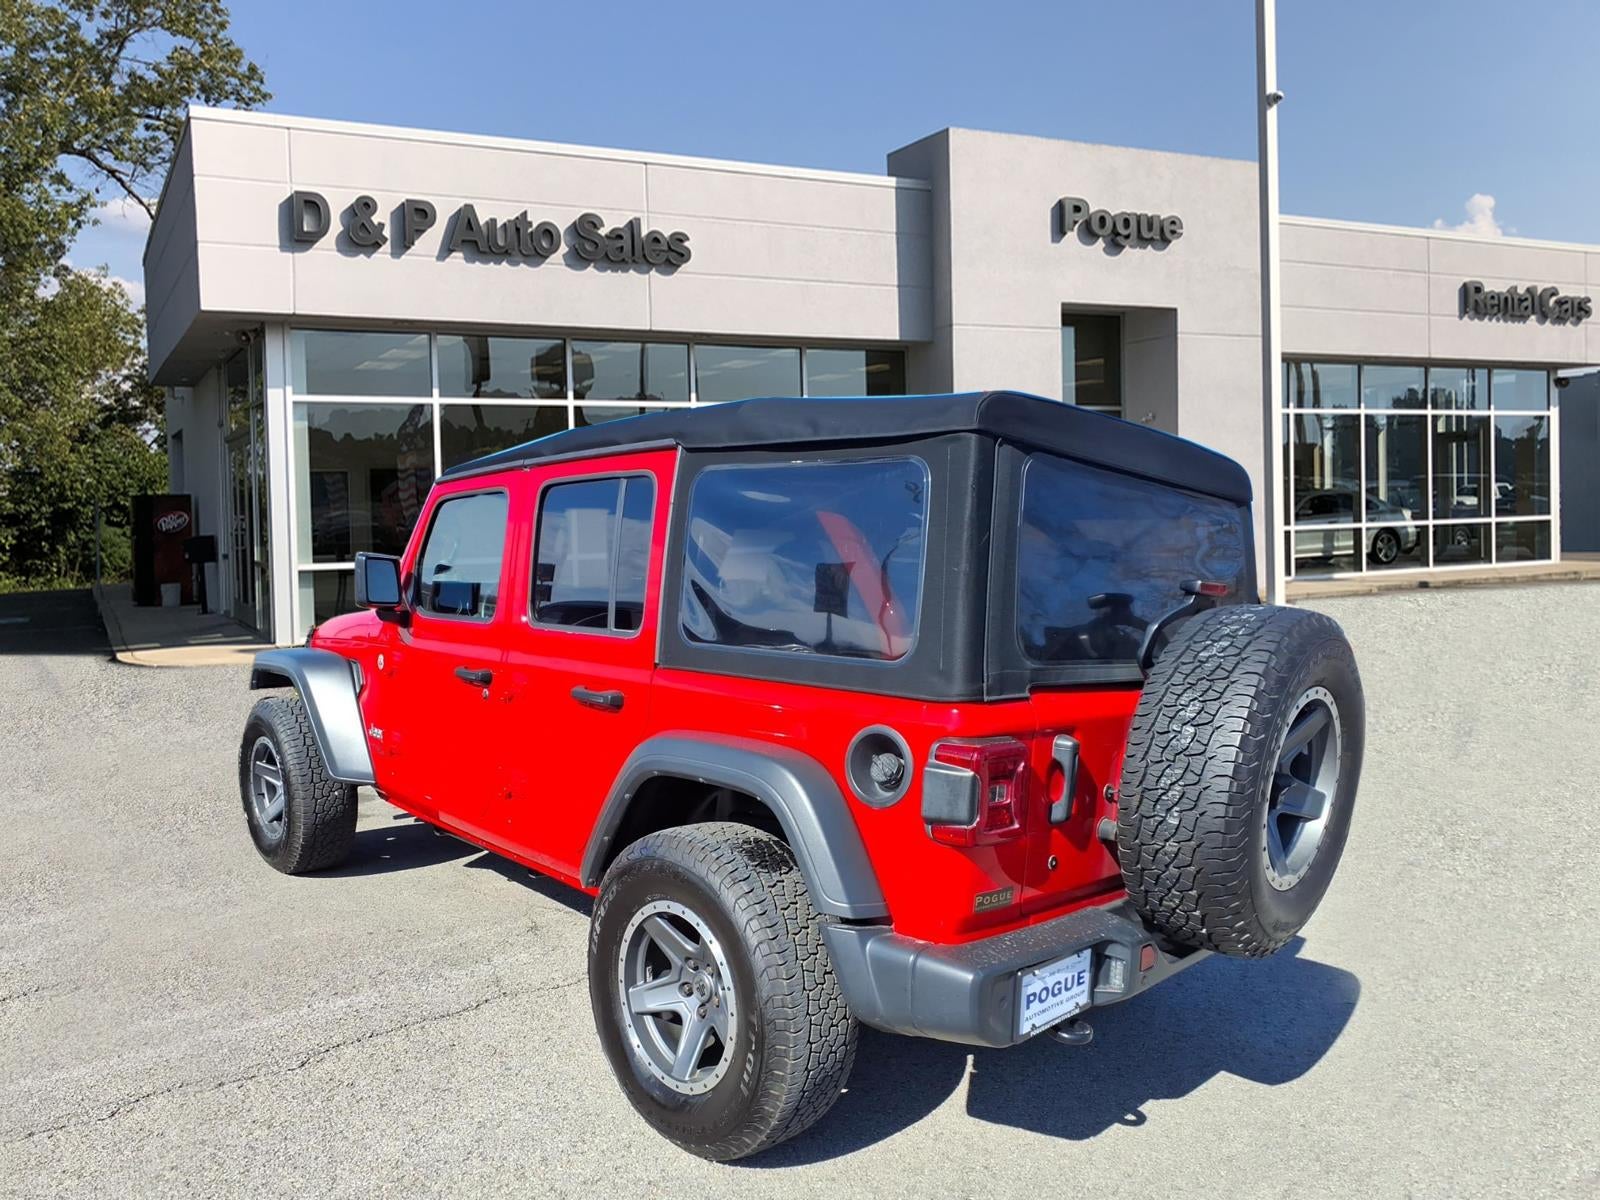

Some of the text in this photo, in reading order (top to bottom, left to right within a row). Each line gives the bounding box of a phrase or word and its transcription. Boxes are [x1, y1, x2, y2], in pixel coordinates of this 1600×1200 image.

[292, 190, 692, 267] D & P Auto Sales
[1057, 197, 1184, 247] Pogue
[1462, 280, 1593, 321] Rental Cars
[975, 890, 1012, 907] POGUE
[1025, 969, 1087, 1010] POGUE
[1025, 1000, 1064, 1022] AUTOMOTIVE
